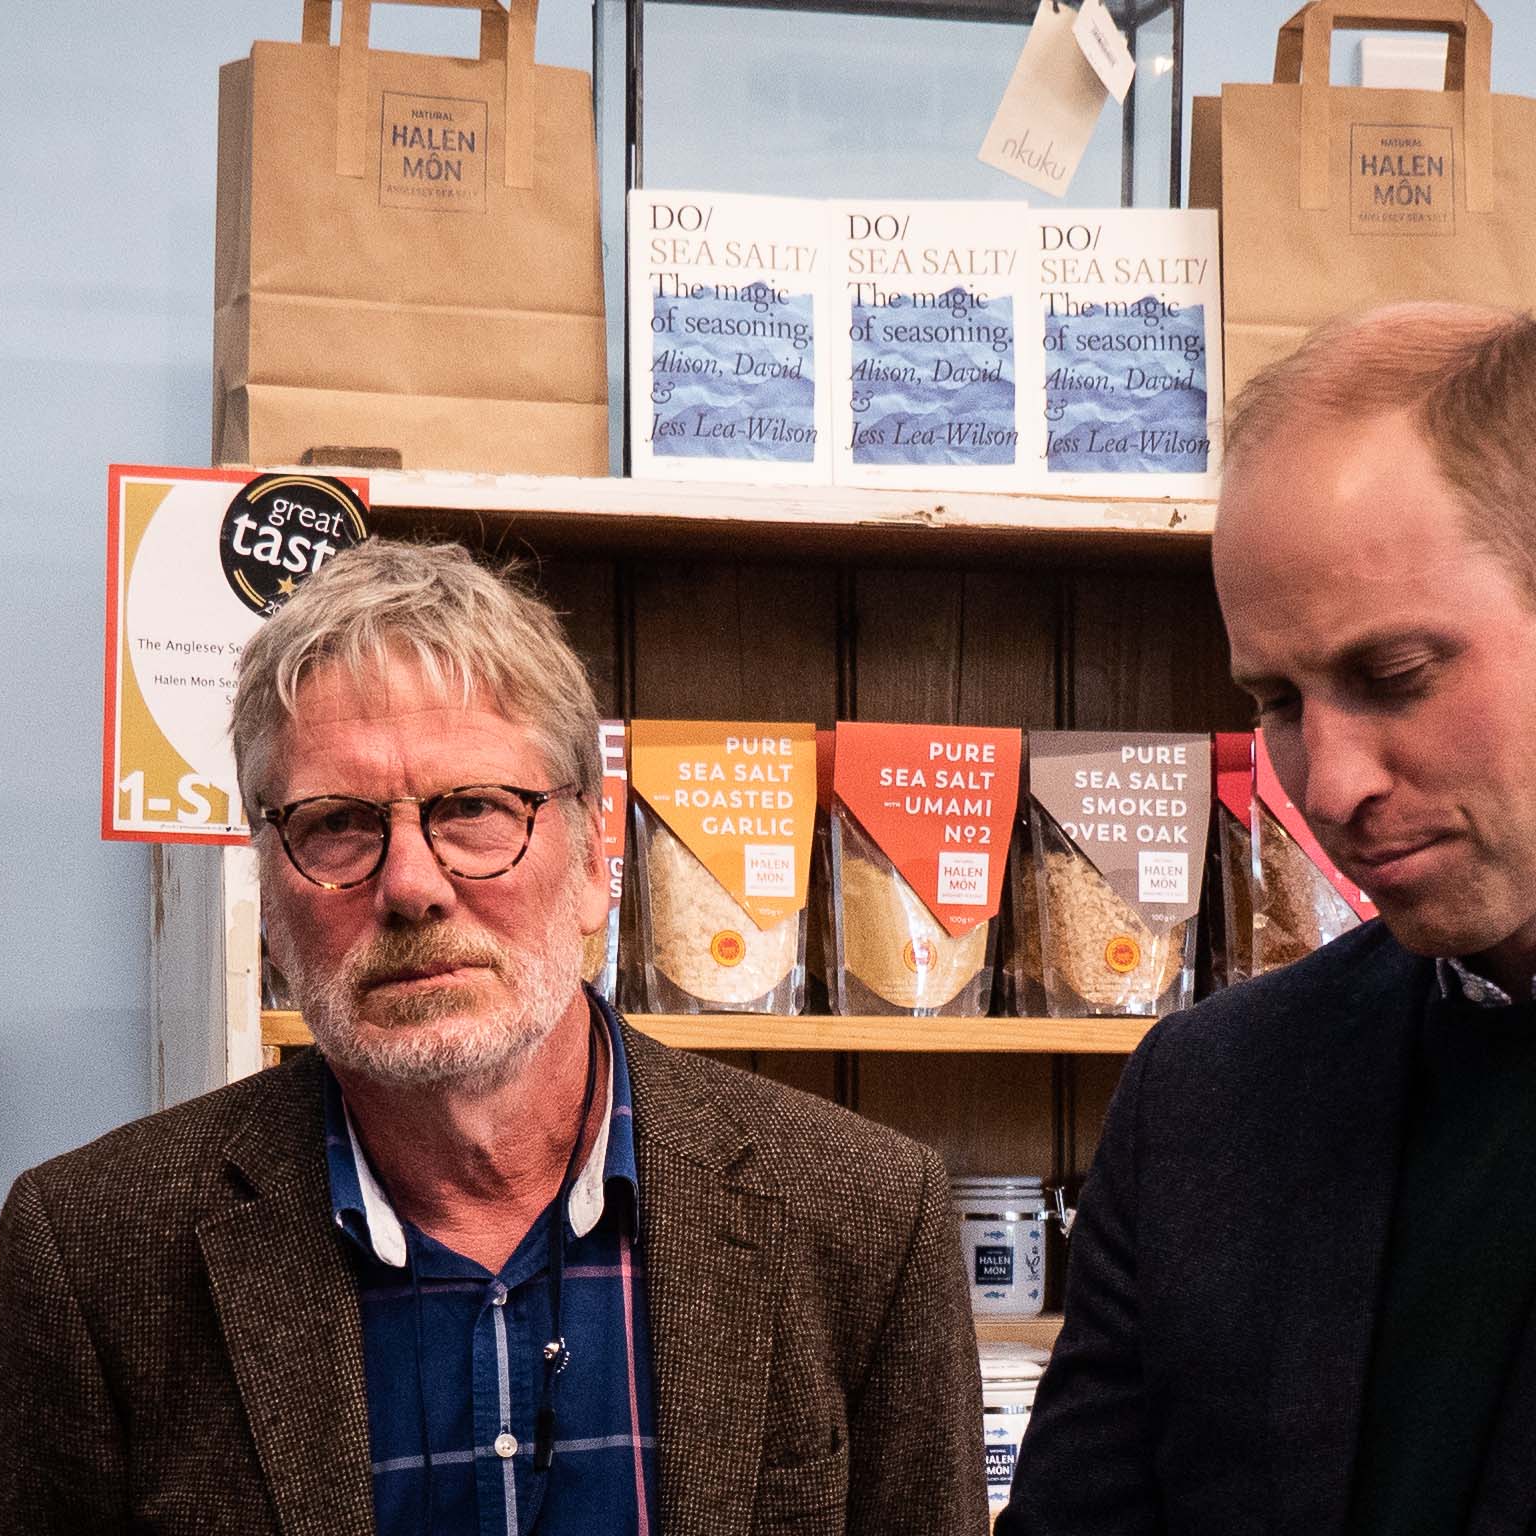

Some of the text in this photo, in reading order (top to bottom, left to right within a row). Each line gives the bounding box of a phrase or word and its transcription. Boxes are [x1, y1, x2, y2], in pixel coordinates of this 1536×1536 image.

[412, 110, 454, 121] NATURAL
[392, 125, 475, 152] HALEN
[403, 152, 462, 181] MÔN
[1002, 129, 1066, 180] nkuku
[1361, 155, 1443, 176] HALEN
[1375, 178, 1431, 205] MÔN
[649, 204, 713, 232] DO/
[846, 214, 910, 241] DO/
[1040, 225, 1102, 251] DO/
[650, 238, 817, 273] SEA SALT/
[847, 248, 1016, 276] SEA SALT/
[1040, 258, 1208, 286] SEA SALT/
[649, 272, 790, 313] The magic
[847, 282, 989, 318] The magic
[1040, 292, 1180, 327] The magic
[650, 306, 813, 349] of seasoning.
[849, 316, 1013, 352] of seasoning.
[1043, 325, 1205, 361] of seasoning.
[650, 350, 803, 379] Alison, David
[849, 359, 1003, 384] Alison, David
[1043, 368, 1194, 392] Alison, David
[645, 413, 818, 444] Jess Lea-Wilson
[845, 421, 1019, 450] Jess Lea-Wilson
[1040, 430, 1211, 458] Jess Lea-Wilson
[268, 498, 345, 538] great
[232, 513, 337, 575] tast
[138, 639, 224, 655] The Anglesey
[154, 675, 214, 687] Halen Mon
[726, 736, 792, 756] PURE
[929, 742, 995, 763] PURE
[1122, 746, 1186, 765] PURE
[679, 762, 794, 782] SEA SALT
[880, 768, 995, 790] SEA SALT
[1075, 770, 1187, 791] SEA SALT
[675, 789, 793, 809] ROASTED
[905, 796, 992, 817] UMAMI
[1082, 797, 1187, 817] SMOKED
[702, 817, 795, 836] GARLIC
[1061, 822, 1188, 844] OVER OAK
[751, 859, 789, 869] HALEN
[944, 867, 982, 877] HALEN
[1144, 866, 1183, 876] HALEN
[979, 1256, 1011, 1265] HALEN
